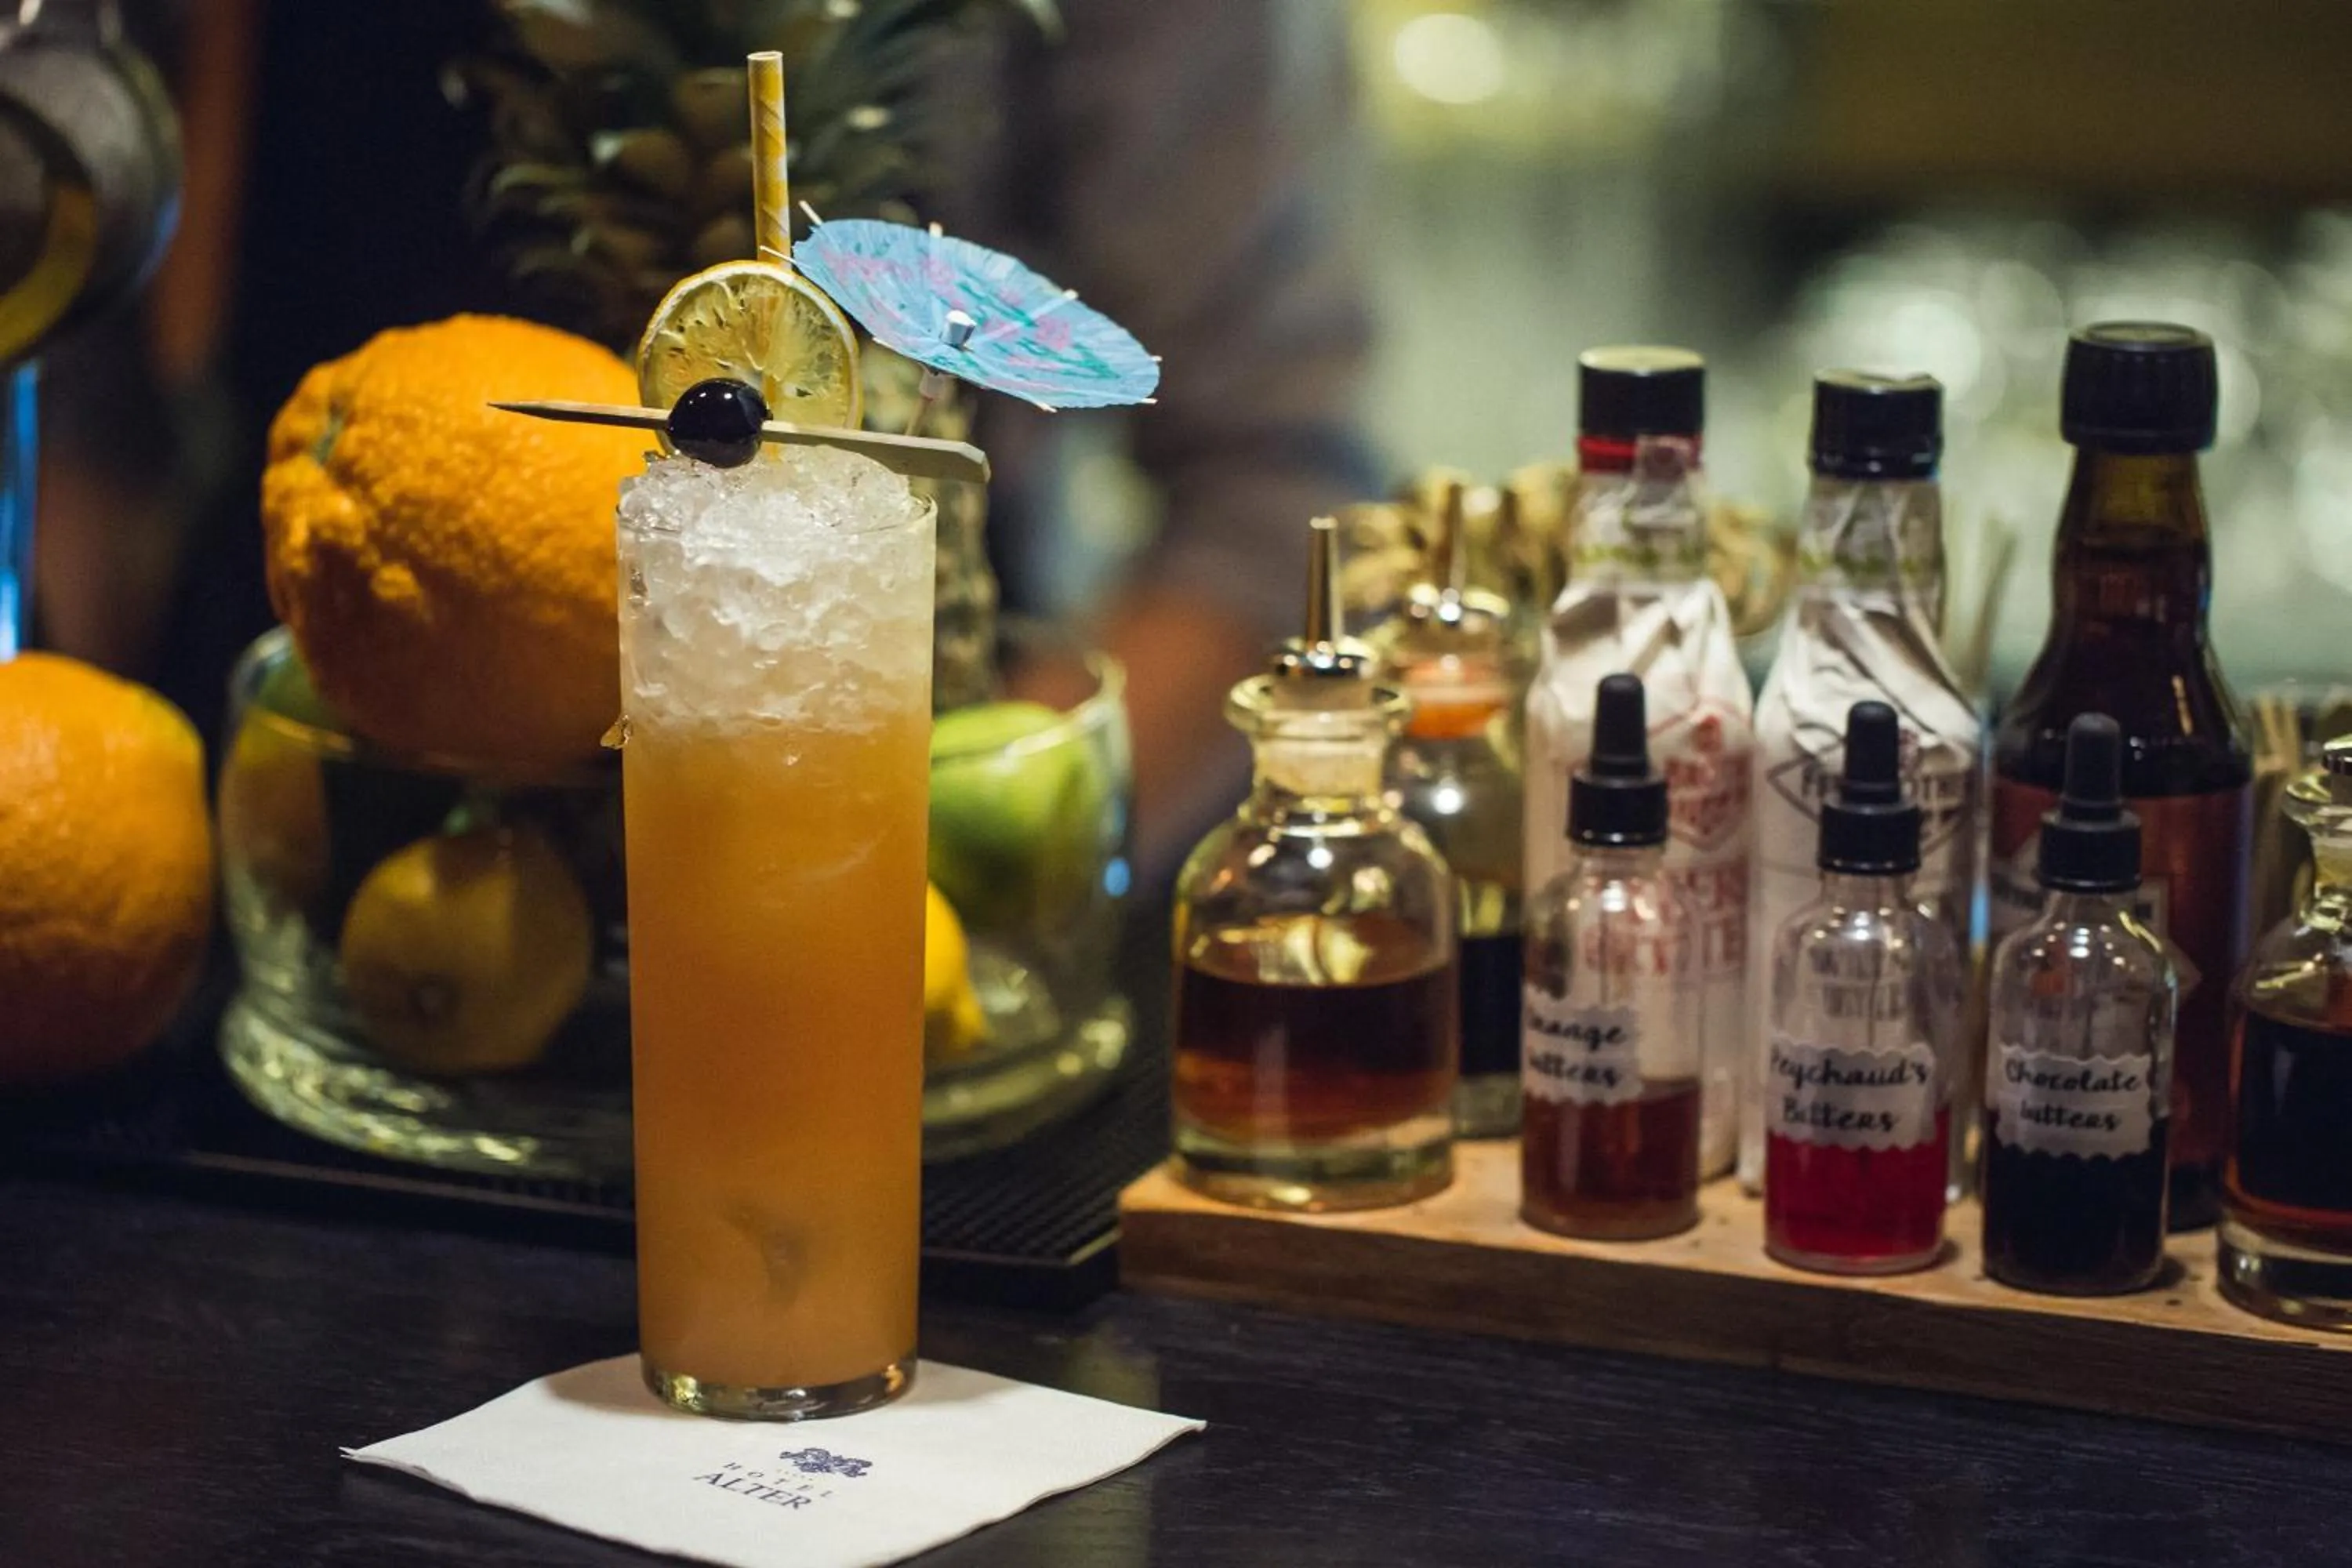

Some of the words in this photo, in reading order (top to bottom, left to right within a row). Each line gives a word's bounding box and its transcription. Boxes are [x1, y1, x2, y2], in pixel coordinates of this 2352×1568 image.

[2005, 1058, 2141, 1091] Chocolate
[693, 1471, 811, 1509] ALTER
[724, 1461, 833, 1497] HOTEL
